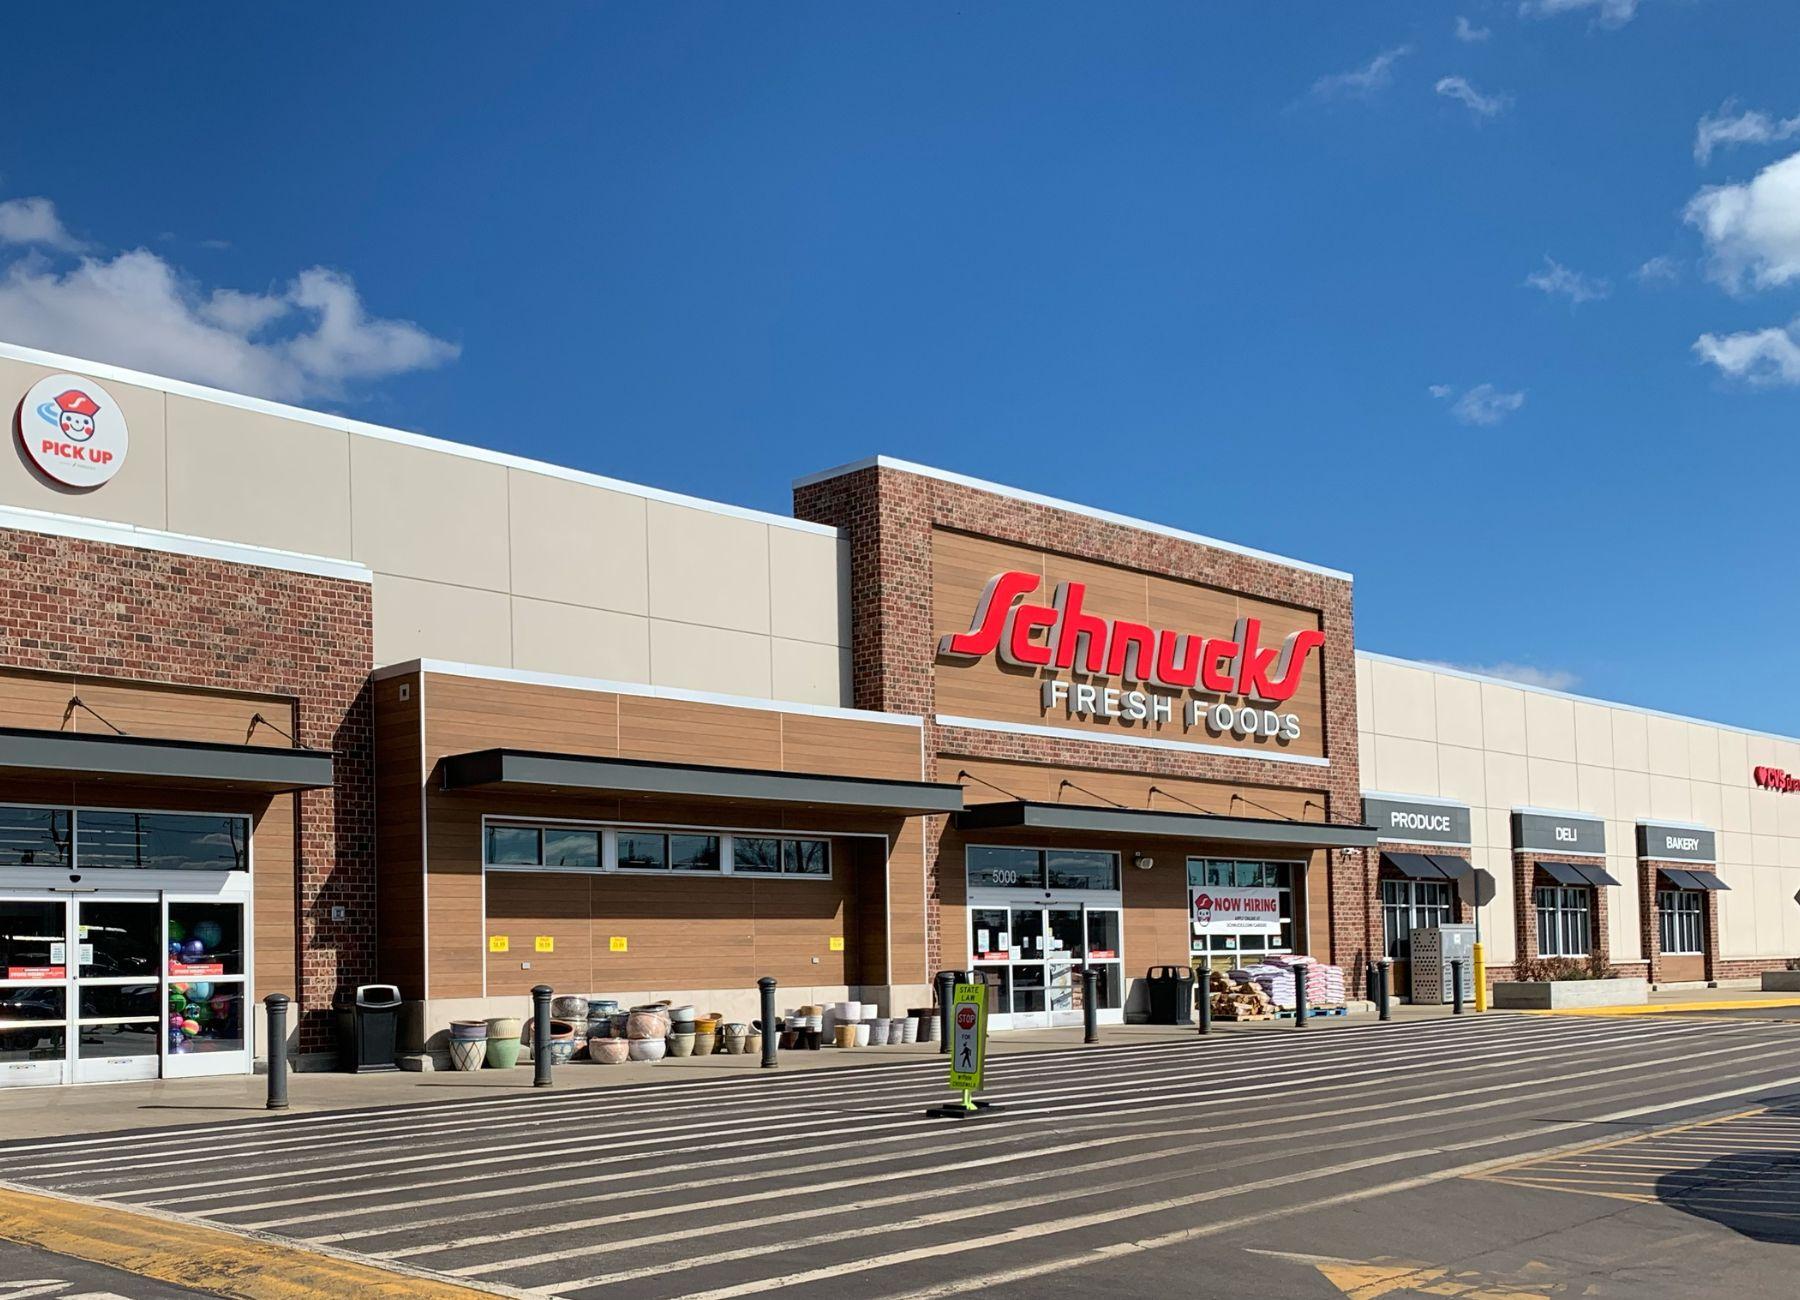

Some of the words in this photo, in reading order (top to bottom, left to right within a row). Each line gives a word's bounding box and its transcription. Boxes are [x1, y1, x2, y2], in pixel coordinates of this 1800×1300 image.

[42, 440, 86, 461] PICK
[89, 448, 113, 465] UP
[950, 571, 1325, 701] Schnucks
[1051, 680, 1172, 722] FRESH
[1193, 700, 1300, 739] FOODS
[1768, 767, 1786, 789] CVS
[1391, 811, 1451, 831] PRODUCE
[1555, 827, 1577, 842] DELI
[1666, 836, 1699, 851] BAKERY
[992, 869, 1017, 884] 5000
[1214, 898, 1240, 911] NOW
[1243, 898, 1276, 912] HIRING
[960, 986, 979, 994] STATE
[958, 1014, 976, 1024] STOP
